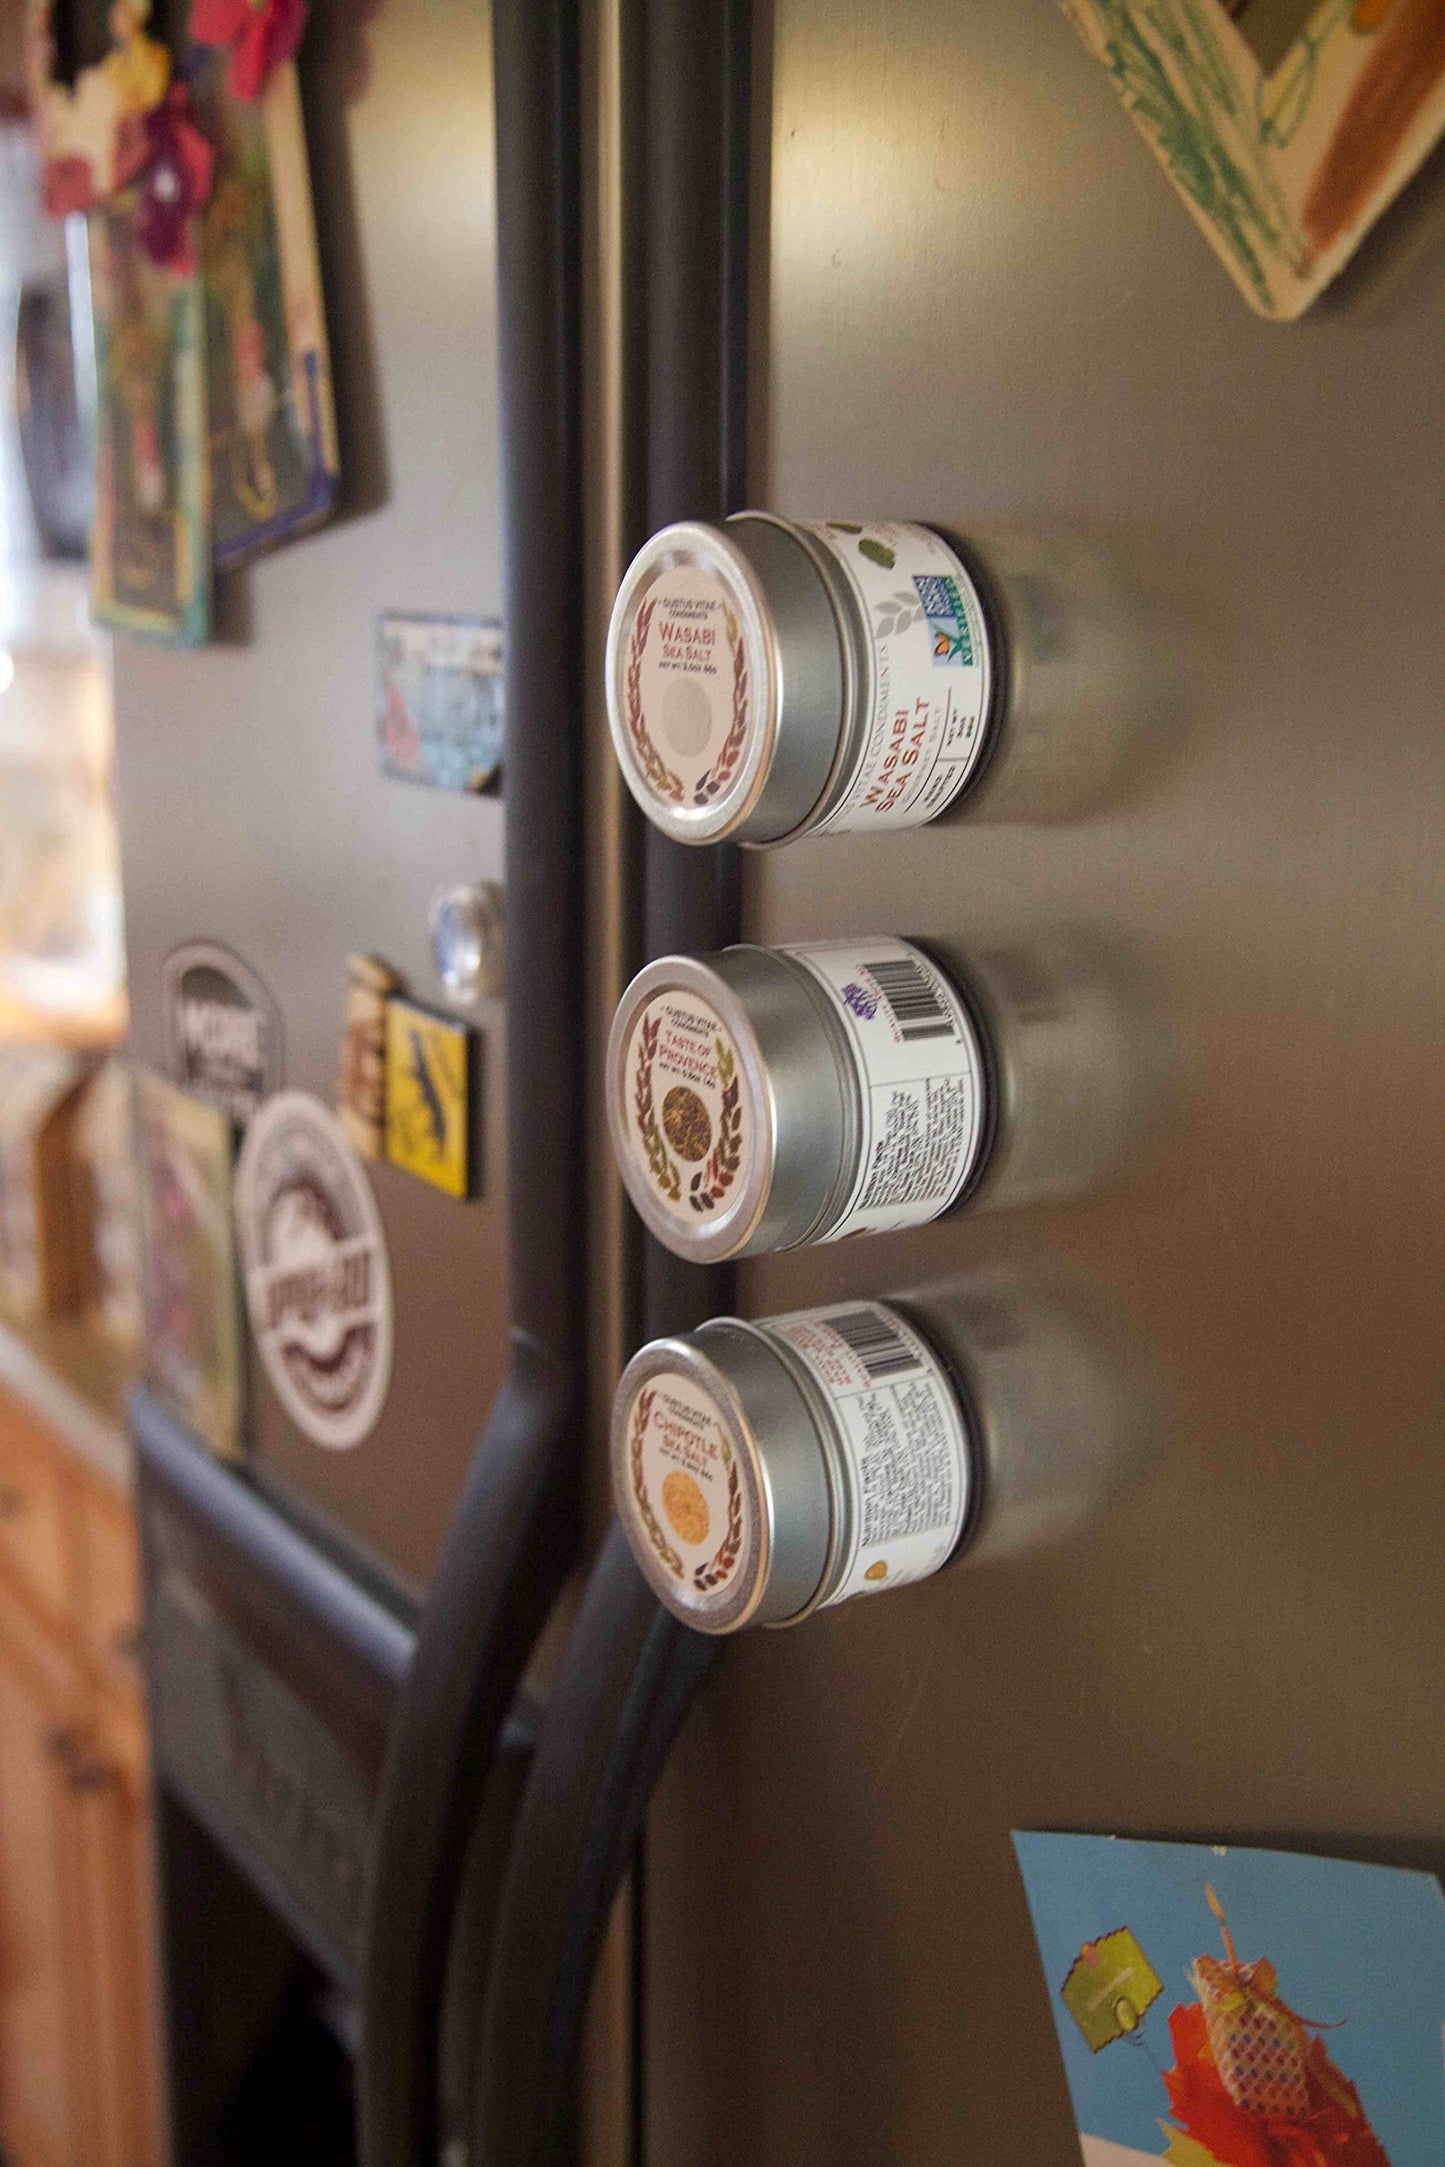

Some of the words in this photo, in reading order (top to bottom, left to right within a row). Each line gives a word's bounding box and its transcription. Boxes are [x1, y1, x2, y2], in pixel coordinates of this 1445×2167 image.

[659, 621, 716, 646] WASABI
[663, 644, 682, 659] SEA
[685, 645, 711, 661] SALT
[859, 708, 909, 809] WASABI
[875, 771, 912, 813] SEA
[902, 695, 930, 767] SALT
[660, 1043, 718, 1079] PROVENCE
[654, 1411, 717, 1459] CHIPOTLE
